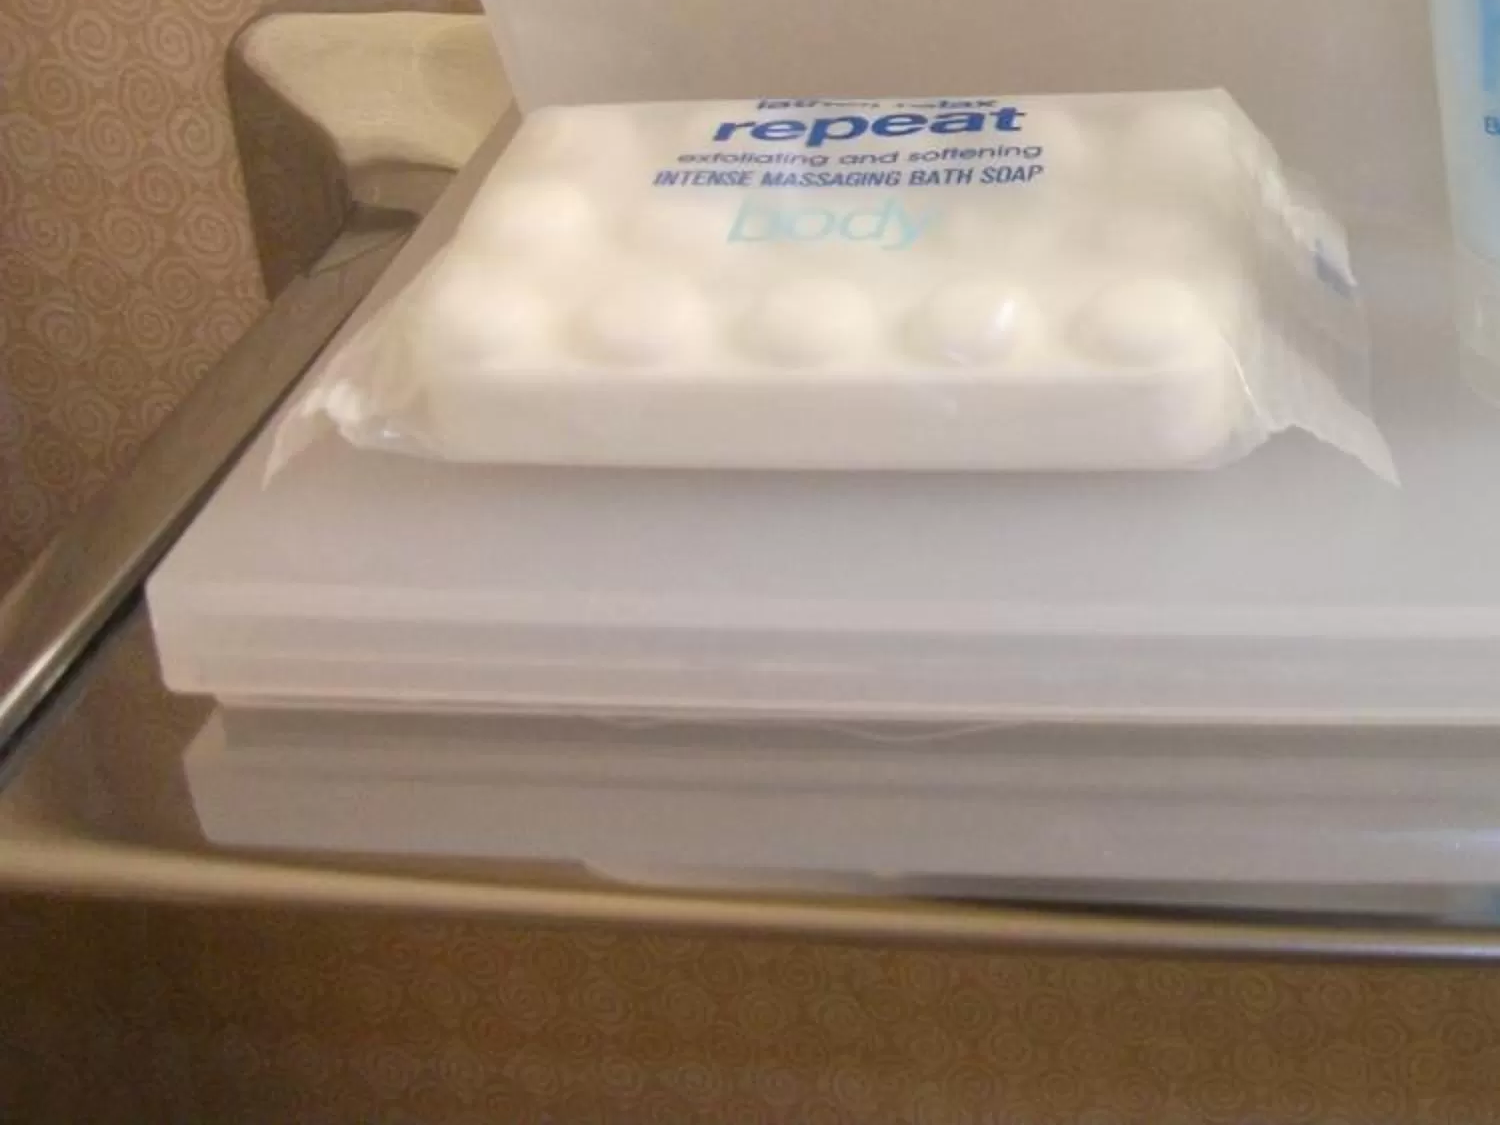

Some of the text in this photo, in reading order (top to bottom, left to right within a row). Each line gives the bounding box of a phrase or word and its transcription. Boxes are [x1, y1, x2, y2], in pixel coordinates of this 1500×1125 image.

[712, 106, 1027, 148] repeat
[677, 145, 1043, 167] exfoliating and softening
[653, 165, 1044, 187] INTENSE MASSAGING BATH SOAP
[728, 192, 943, 251] body
